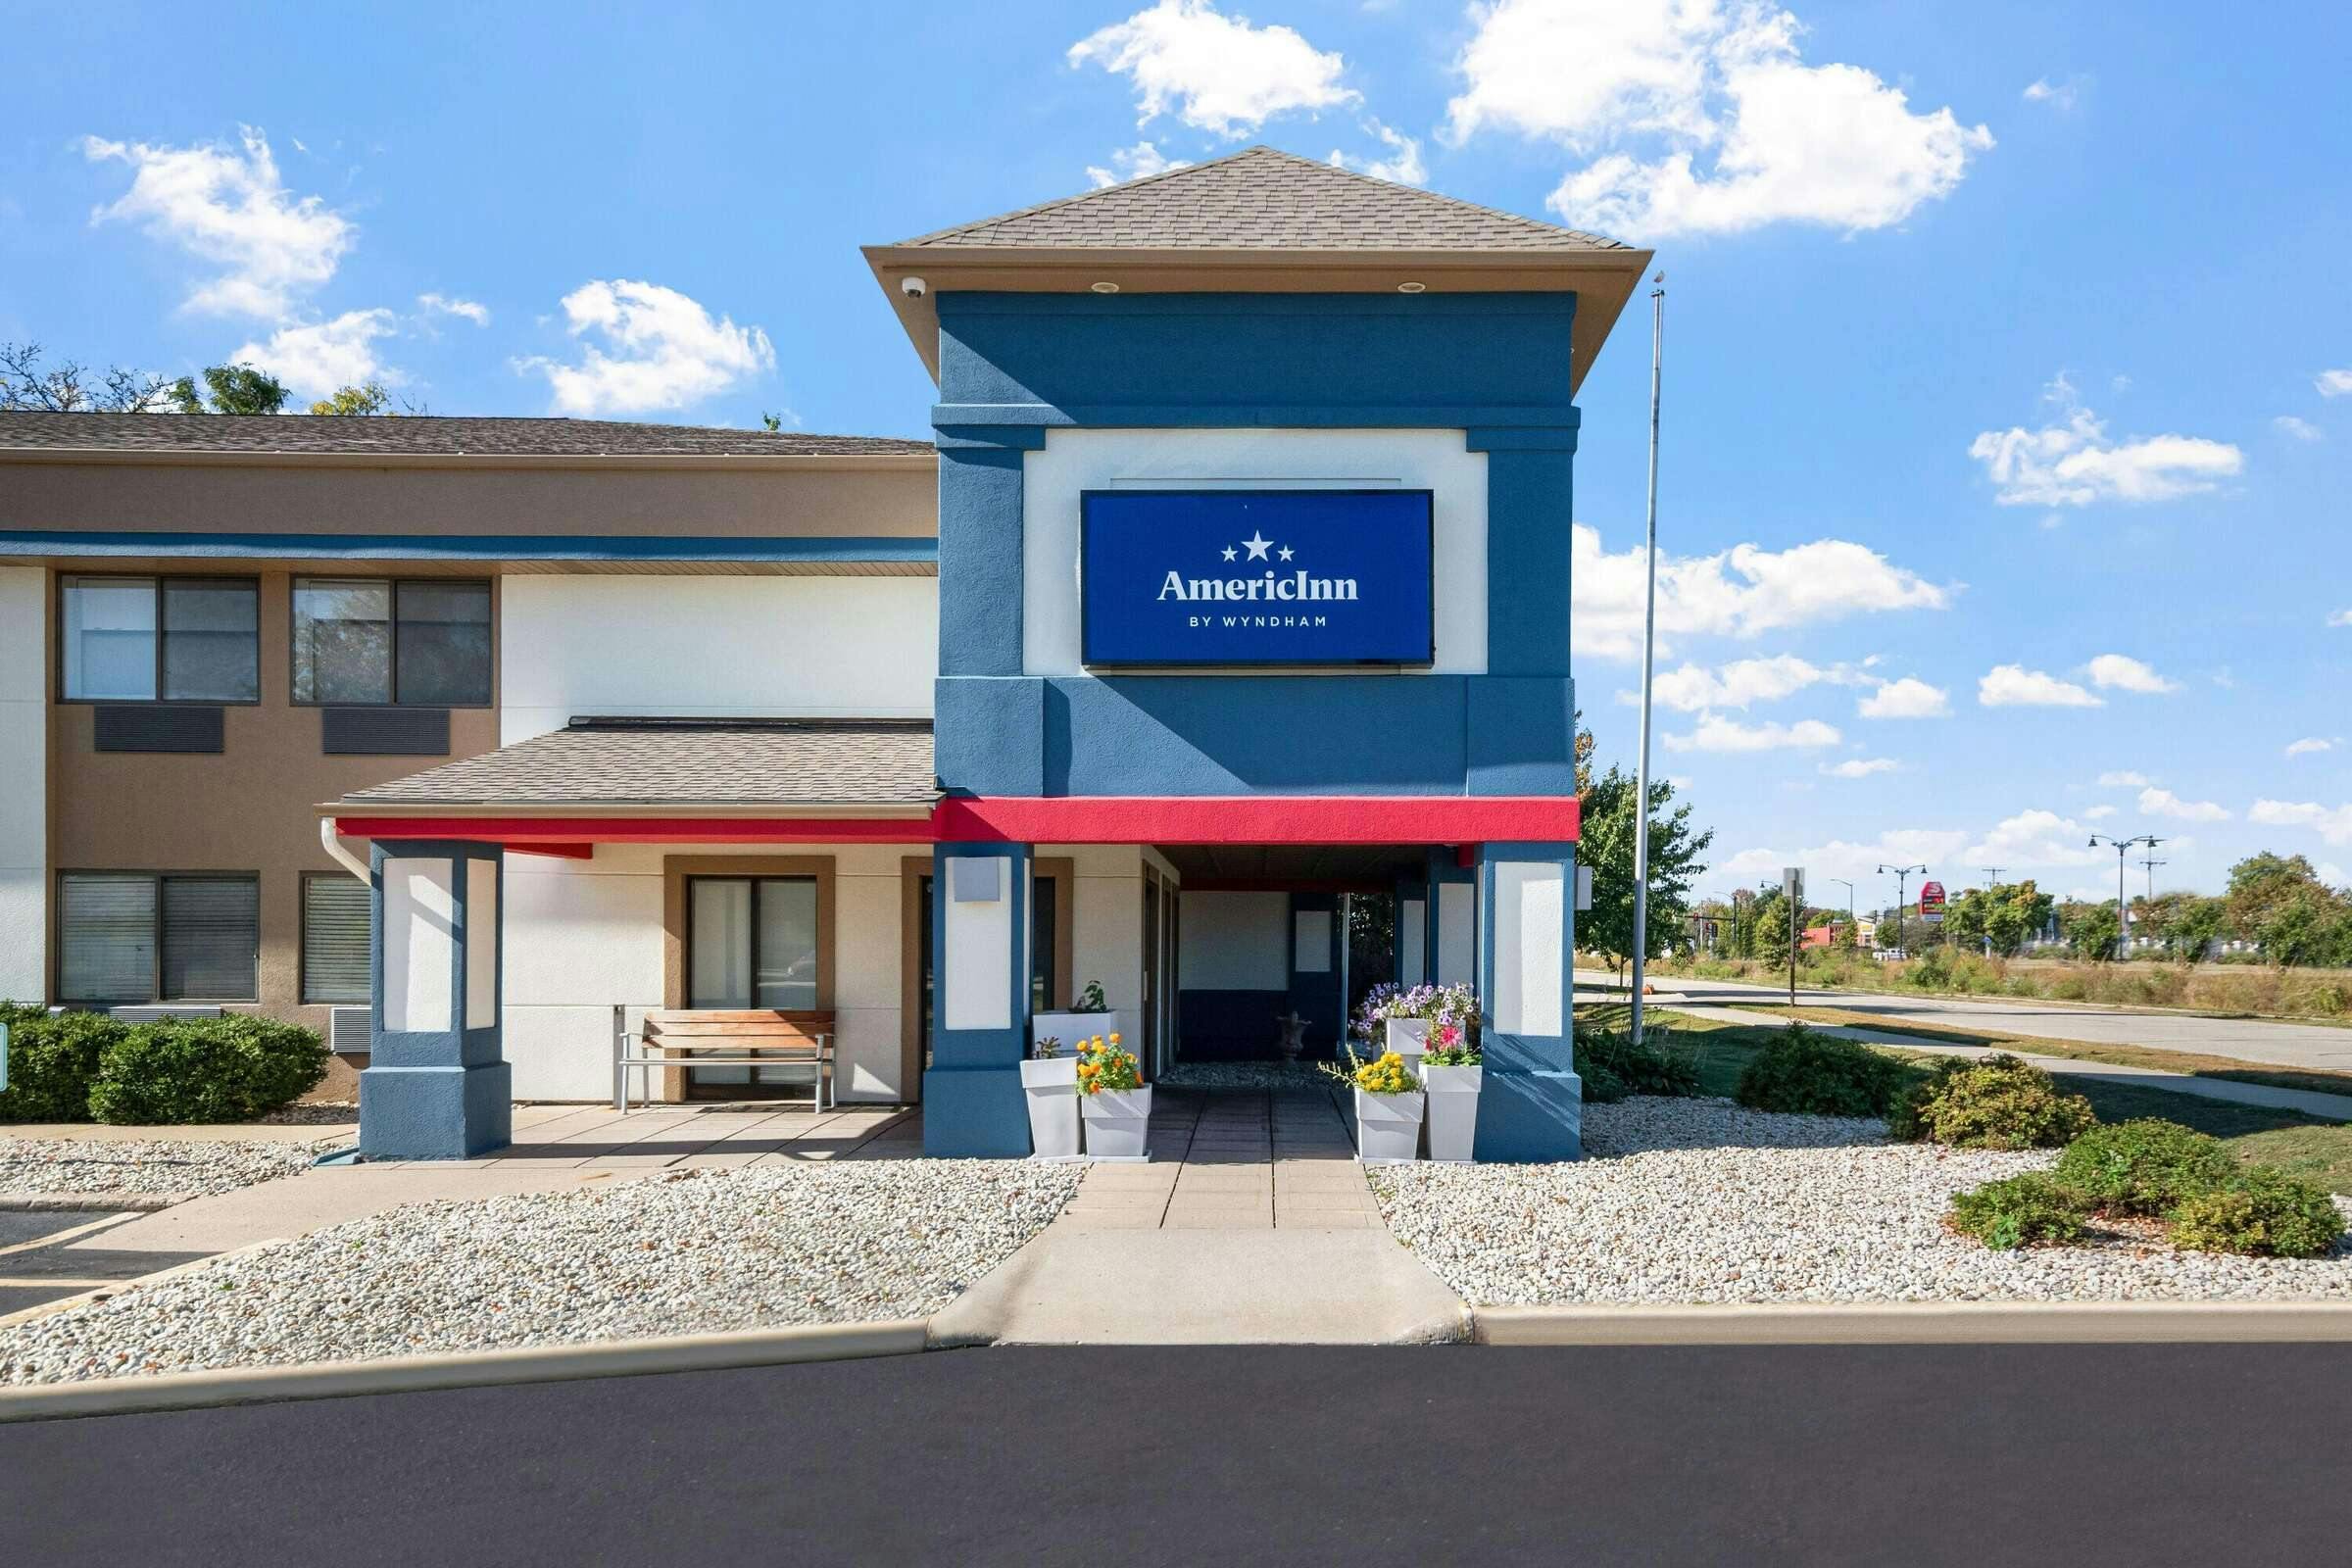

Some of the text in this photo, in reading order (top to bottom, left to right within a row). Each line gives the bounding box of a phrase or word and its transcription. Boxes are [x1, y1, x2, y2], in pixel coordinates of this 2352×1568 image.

[1156, 570, 1359, 601] AmericInn
[1190, 616, 1327, 627] BY WYNDHAM
